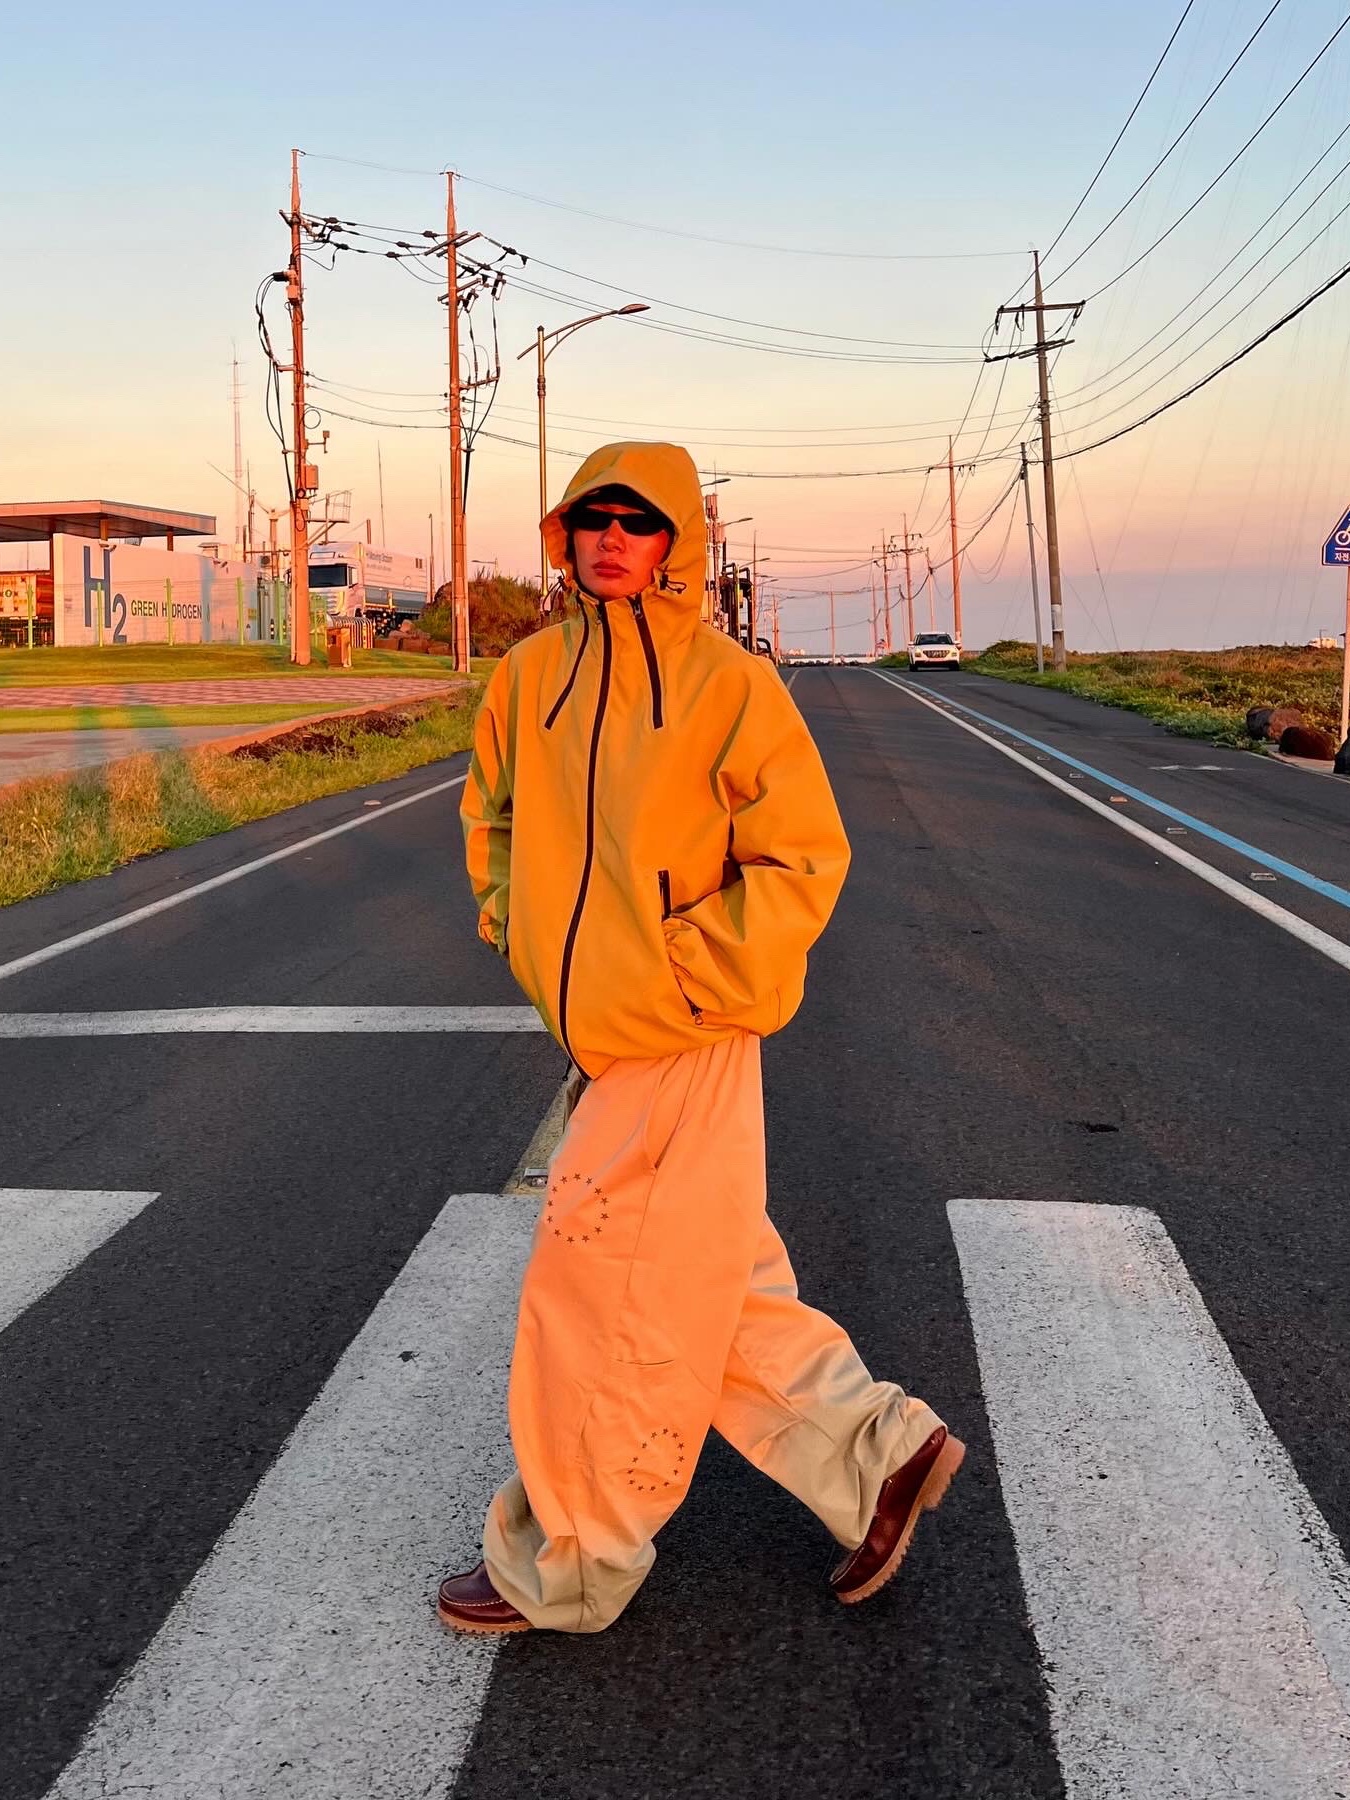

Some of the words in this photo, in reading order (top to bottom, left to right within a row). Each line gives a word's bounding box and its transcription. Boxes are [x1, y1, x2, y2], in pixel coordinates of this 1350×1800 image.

[83, 545, 127, 644] H2
[131, 600, 159, 617] GREEN
[162, 602, 202, 619] HDROGEN
